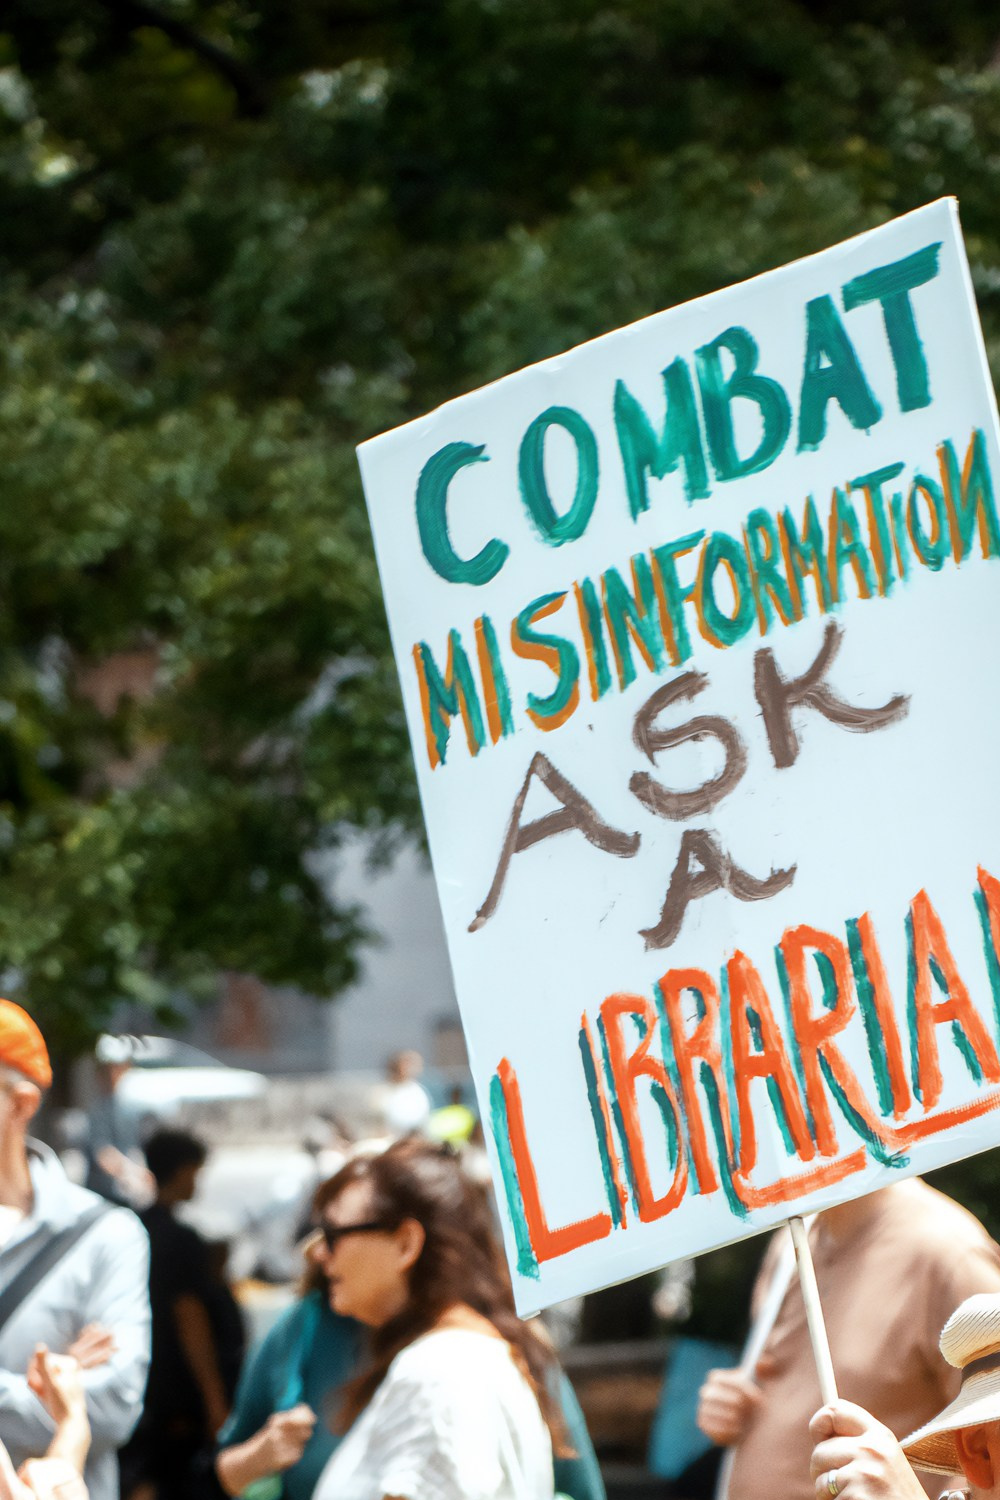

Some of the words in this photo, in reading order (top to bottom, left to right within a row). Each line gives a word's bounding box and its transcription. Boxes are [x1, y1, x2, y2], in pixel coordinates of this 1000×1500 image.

[415, 241, 944, 586] COMBAT
[468, 620, 911, 933] ASK
[638, 829, 798, 950] A
